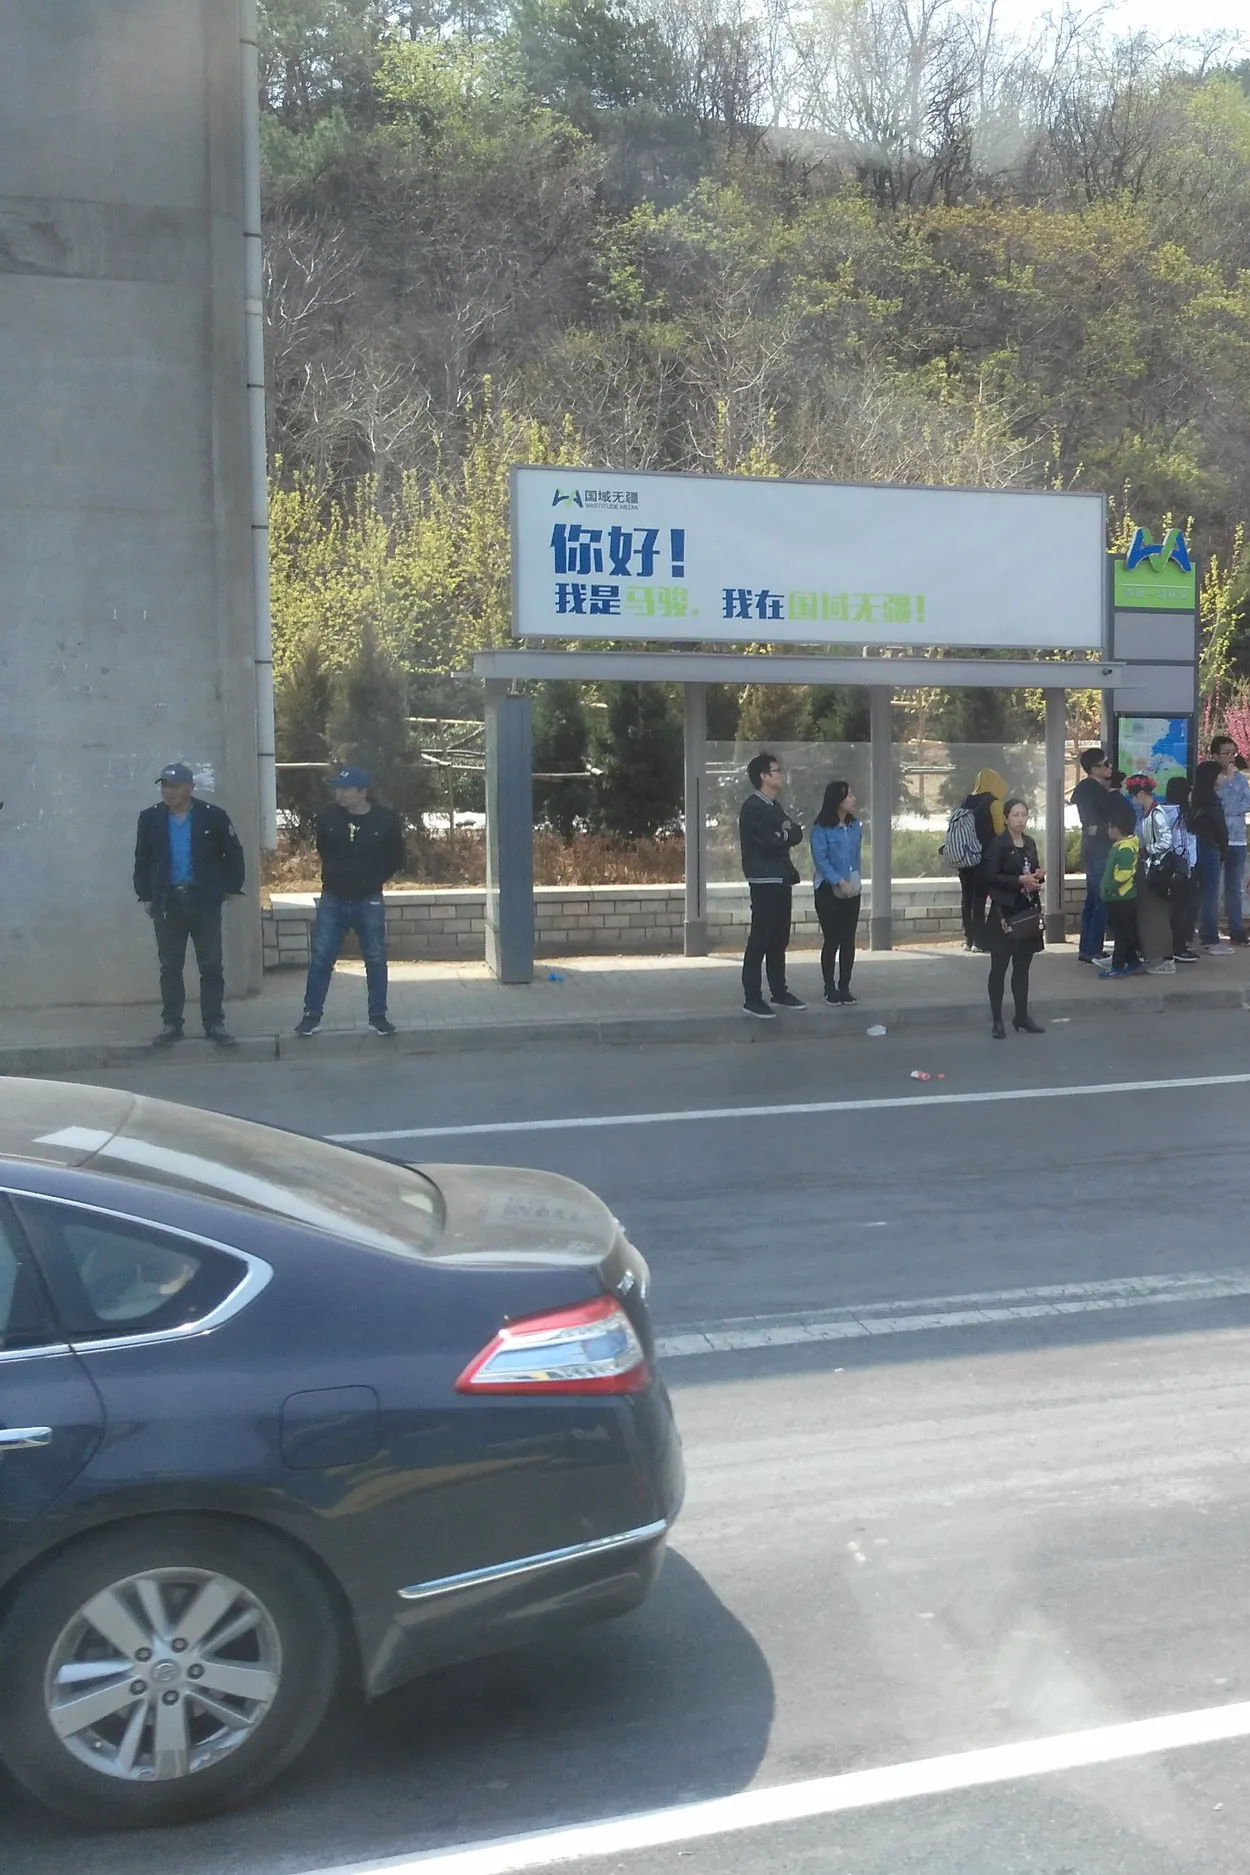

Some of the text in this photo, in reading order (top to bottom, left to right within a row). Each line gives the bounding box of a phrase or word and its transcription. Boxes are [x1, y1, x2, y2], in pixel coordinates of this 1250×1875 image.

[584, 490, 639, 504] 国域无疆
[550, 523, 685, 578] 你好！
